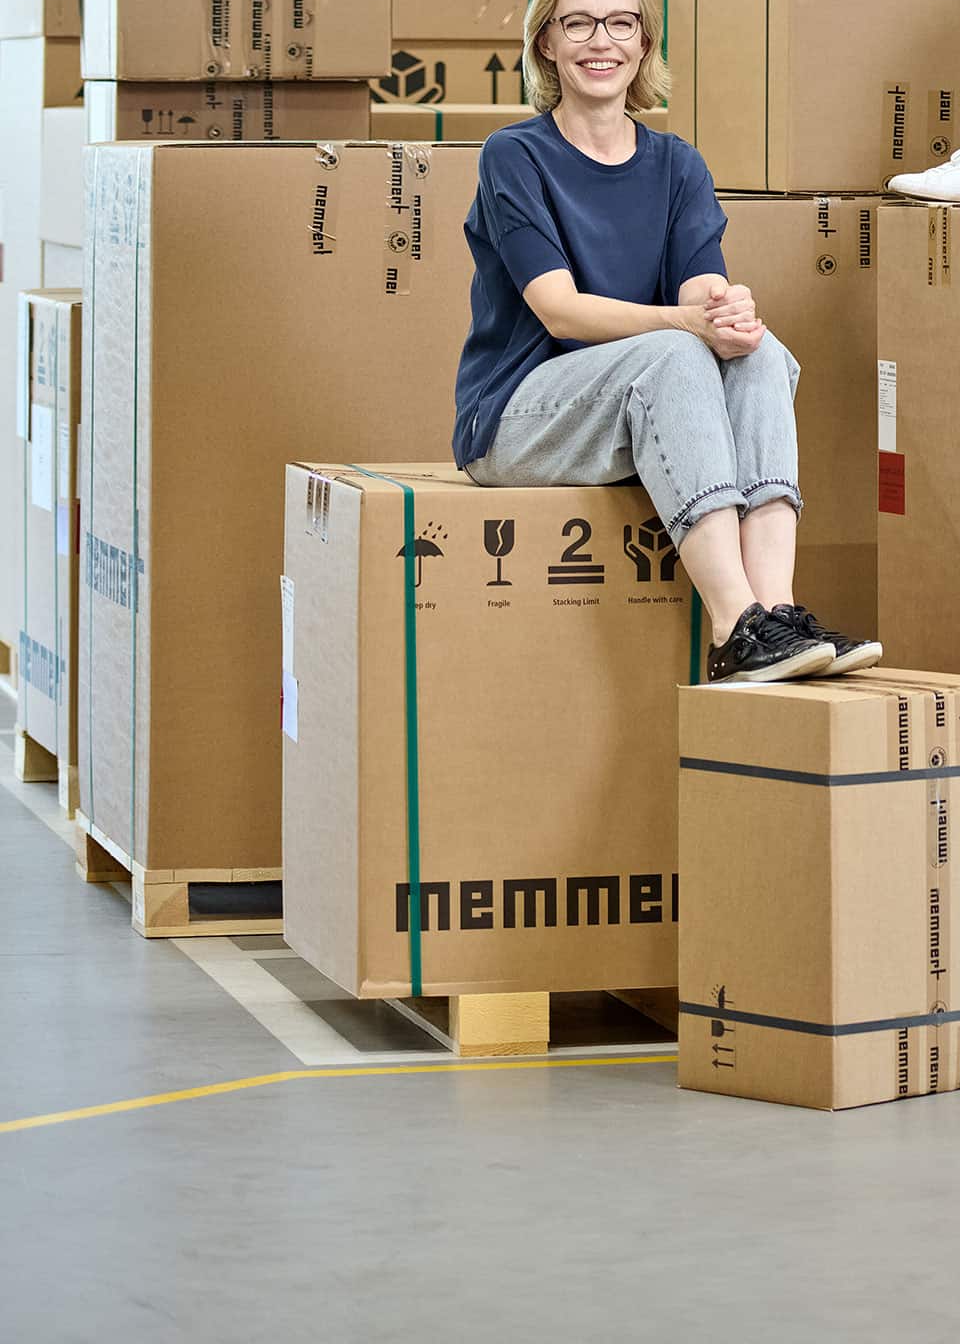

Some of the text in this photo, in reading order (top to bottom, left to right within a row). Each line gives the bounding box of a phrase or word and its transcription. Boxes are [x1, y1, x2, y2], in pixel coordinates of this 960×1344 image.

[888, 85, 906, 160] memmert
[860, 209, 870, 269] memme
[560, 518, 593, 562] 2
[425, 600, 437, 610] dry
[487, 599, 511, 609] Fragile
[552, 597, 600, 607] Stacking Limit
[627, 596, 683, 605] Handle with care
[396, 873, 679, 933] memme
[930, 888, 946, 981] memmert
